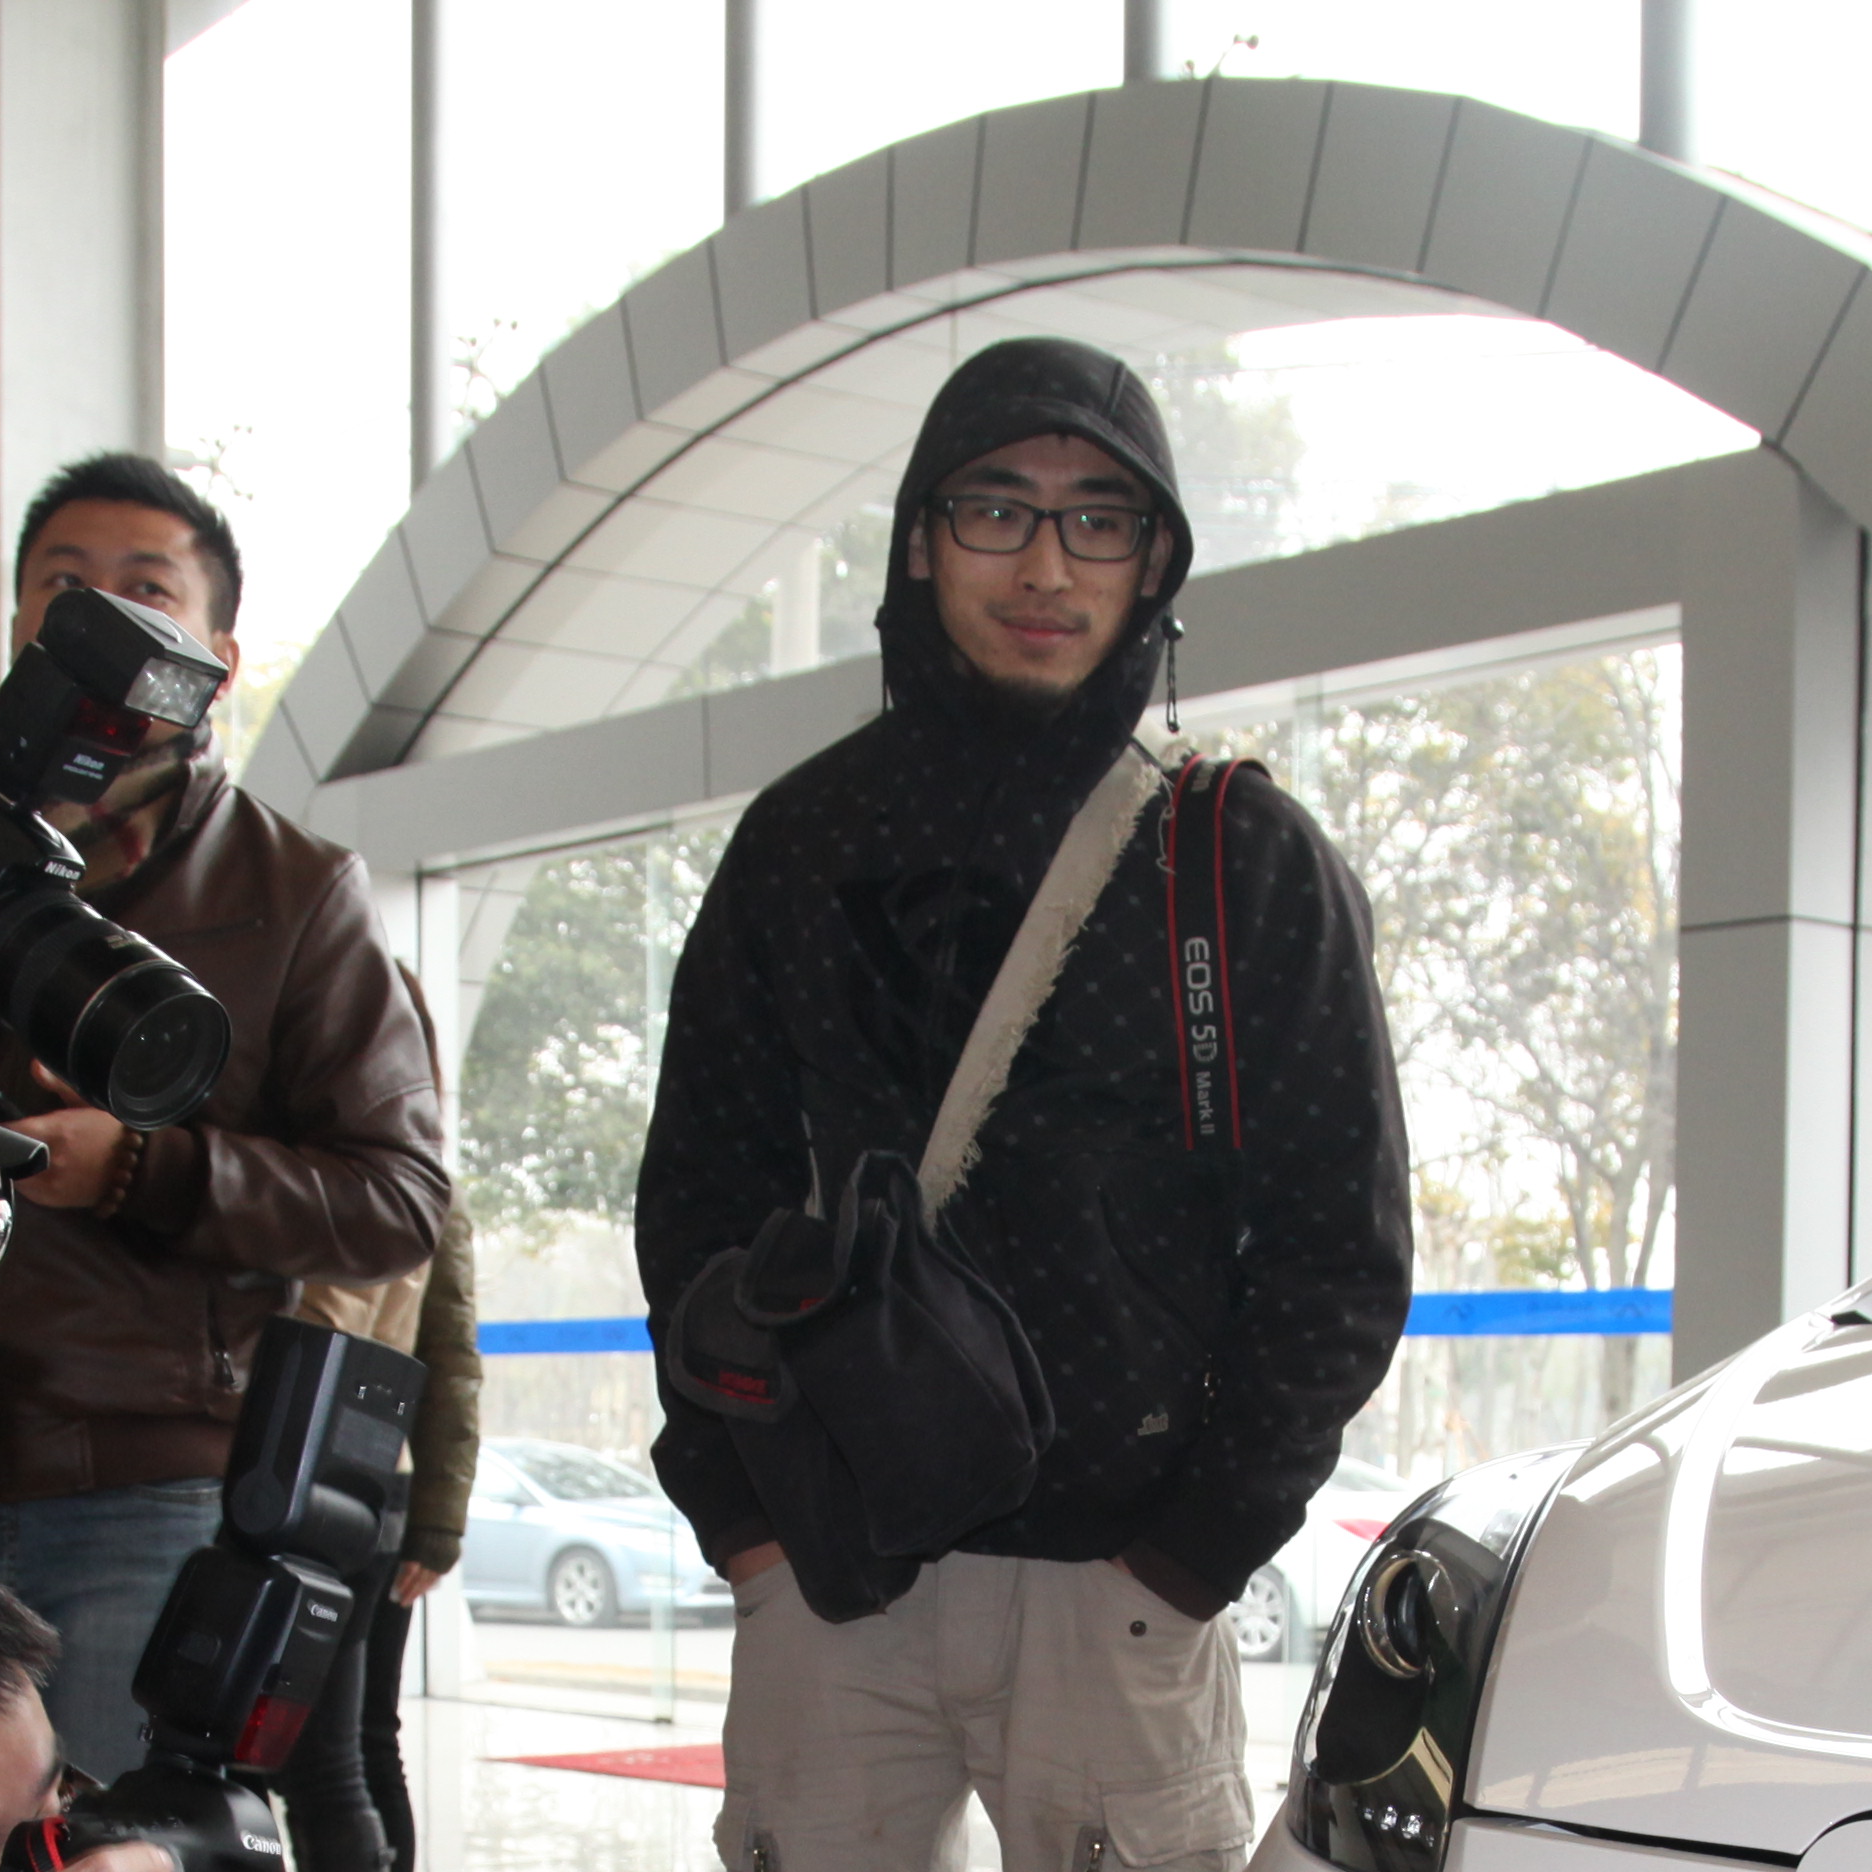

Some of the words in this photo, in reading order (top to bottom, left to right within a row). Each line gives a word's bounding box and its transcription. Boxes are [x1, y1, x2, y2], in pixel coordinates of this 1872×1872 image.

[73, 754, 105, 770] Nikon
[44, 860, 82, 881] Nikon
[1184, 936, 1214, 1016] EOS
[1191, 1024, 1218, 1063] 5D
[1195, 1071, 1216, 1121] Mark
[309, 1603, 339, 1623] Canon
[241, 1833, 283, 1856] Canon
